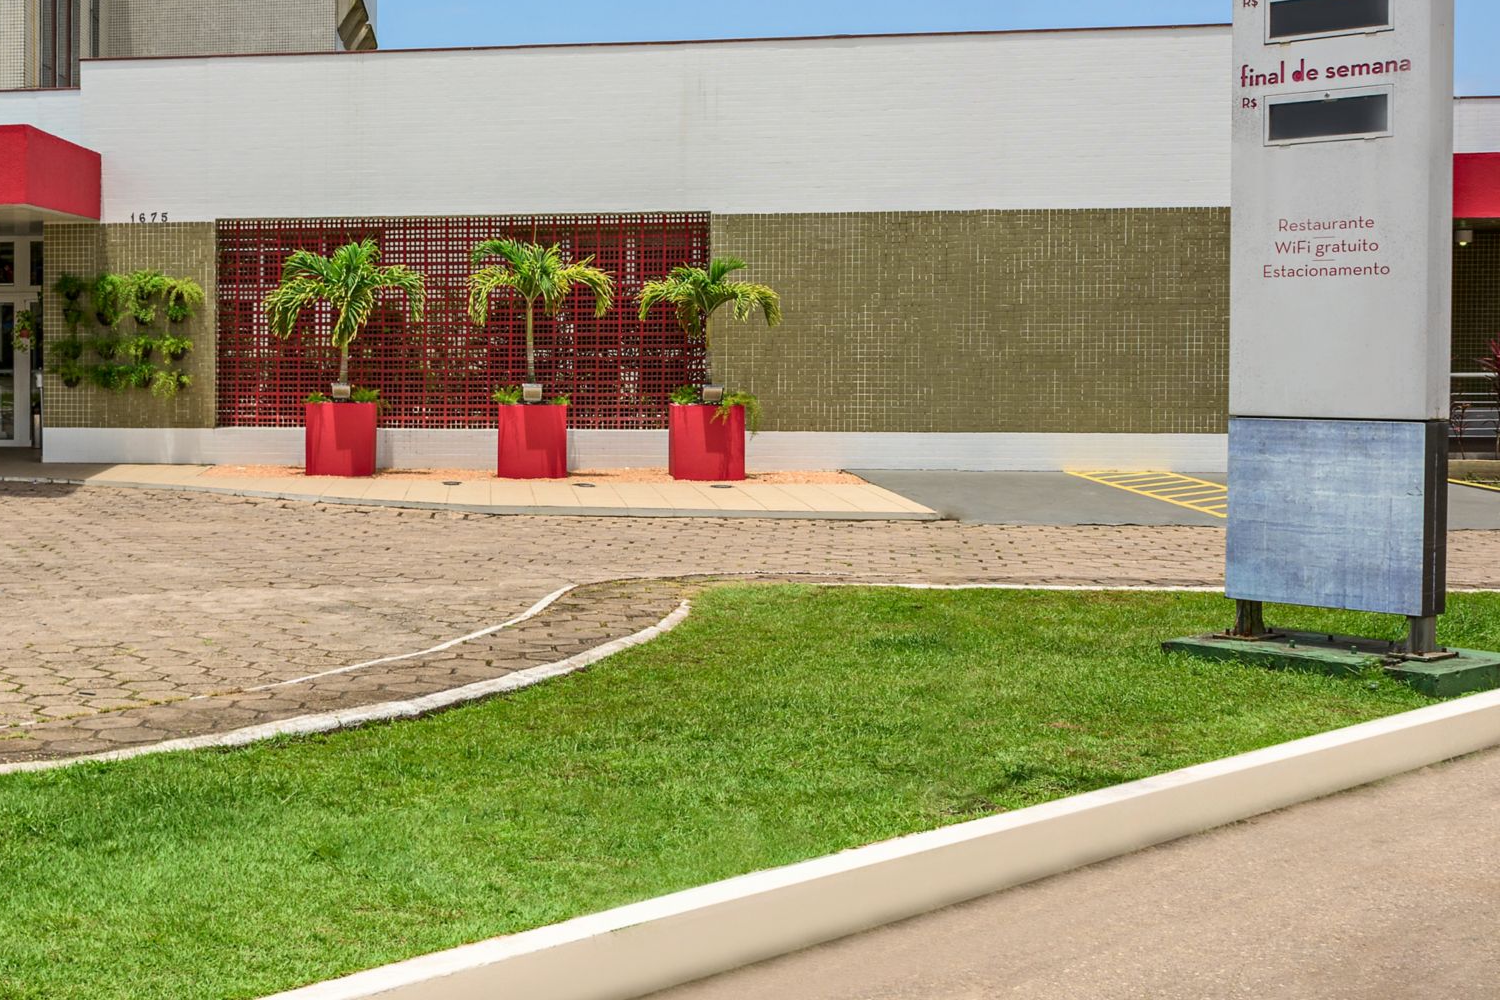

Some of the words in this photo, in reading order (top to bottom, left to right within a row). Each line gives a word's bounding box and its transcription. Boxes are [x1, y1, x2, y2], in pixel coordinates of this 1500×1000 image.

[1240, 61, 1285, 88] final
[1292, 59, 1319, 83] de
[1325, 58, 1412, 80] semana
[1242, 98, 1257, 109] R$
[131, 212, 168, 223] 1675
[1278, 216, 1375, 232] Restaurante
[1275, 241, 1311, 254] WiFi
[1315, 239, 1379, 257] gratuito
[1263, 262, 1390, 279] Estacionamento
